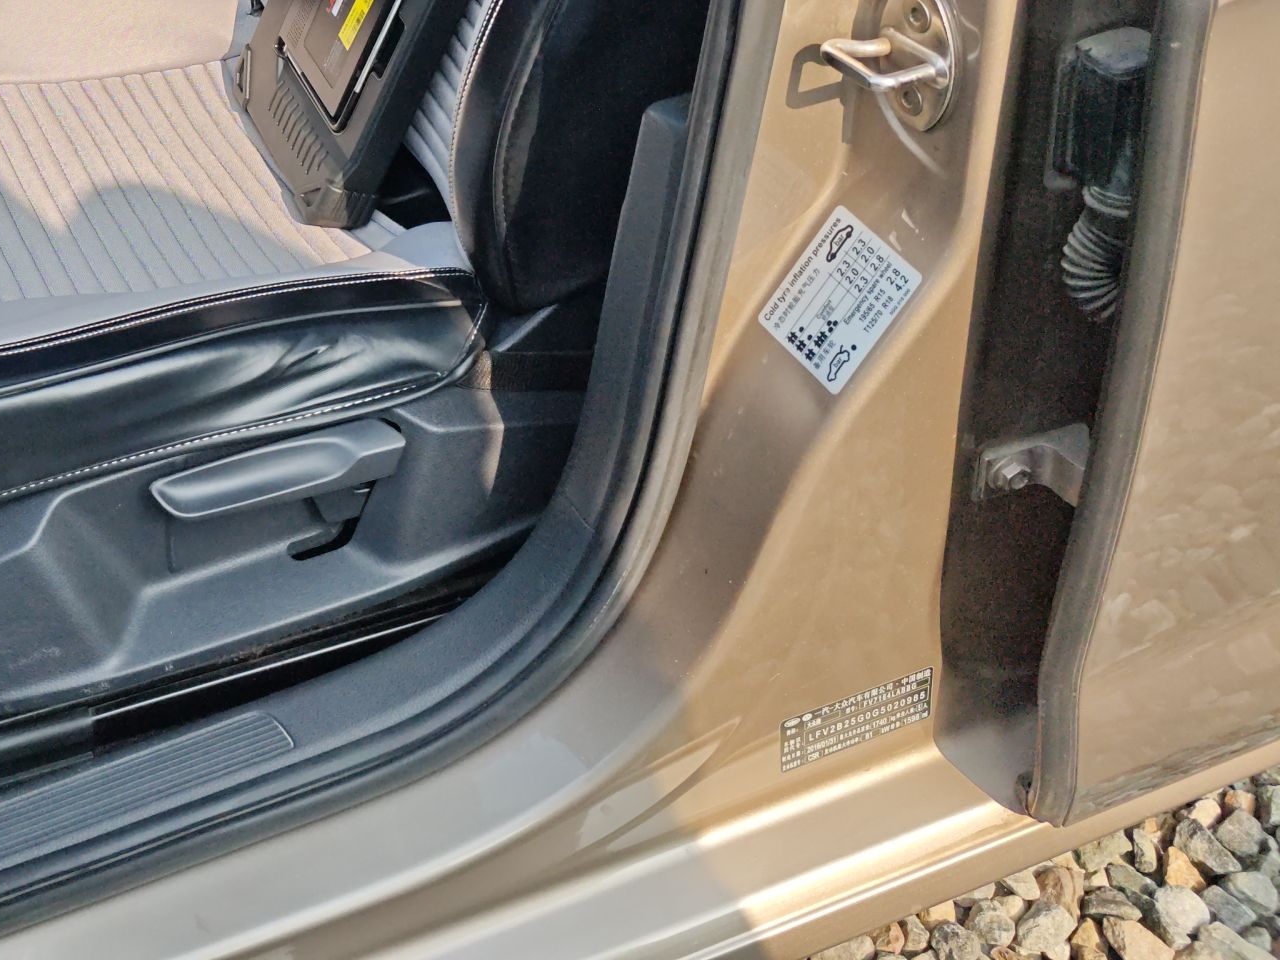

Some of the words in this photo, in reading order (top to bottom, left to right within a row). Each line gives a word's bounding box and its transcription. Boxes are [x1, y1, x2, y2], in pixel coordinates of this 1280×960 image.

[833, 232, 844, 247] bar
[835, 258, 851, 277] 2.3
[851, 237, 866, 255] 2.3
[762, 300, 780, 322] Cold
[787, 253, 813, 288] inflation
[810, 215, 842, 257] pressures
[844, 266, 860, 285] 2.0
[859, 245, 875, 263] 2.0
[853, 274, 869, 293] 2.3
[869, 253, 884, 271] 2.8
[893, 274, 909, 293] 4.2
[842, 292, 869, 326] Emergency
[865, 277, 881, 296] spare
[876, 259, 892, 279] wheel
[858, 301, 875, 323] 195/65
[873, 287, 886, 302] R15
[885, 267, 901, 286] 2.8
[832, 355, 843, 369] bar
